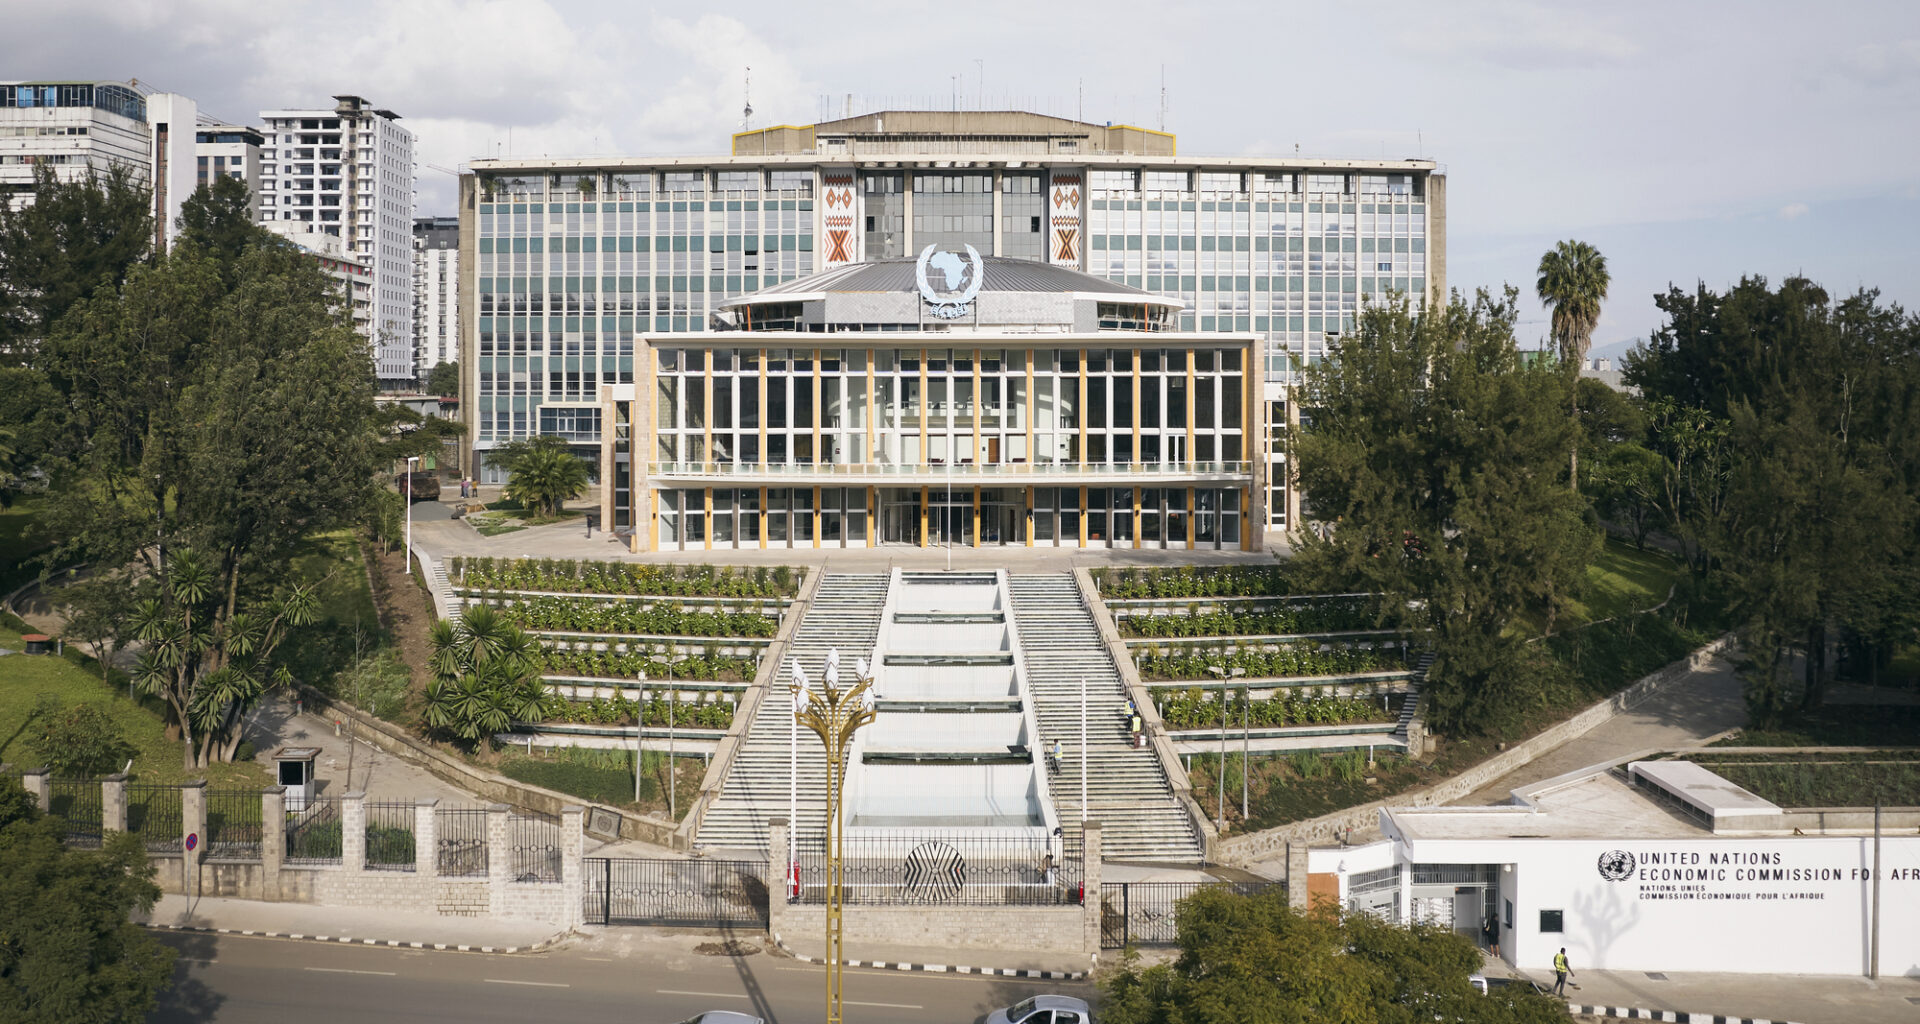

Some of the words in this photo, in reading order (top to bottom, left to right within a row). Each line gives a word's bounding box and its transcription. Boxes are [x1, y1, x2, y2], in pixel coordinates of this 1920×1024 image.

[1640, 852, 1700, 864] UNITED
[1710, 852, 1781, 864] NATIONS
[1640, 868, 1726, 881] ECONOMIC
[1736, 868, 1842, 881] COMMISSION
[1852, 868, 1881, 881] FO
